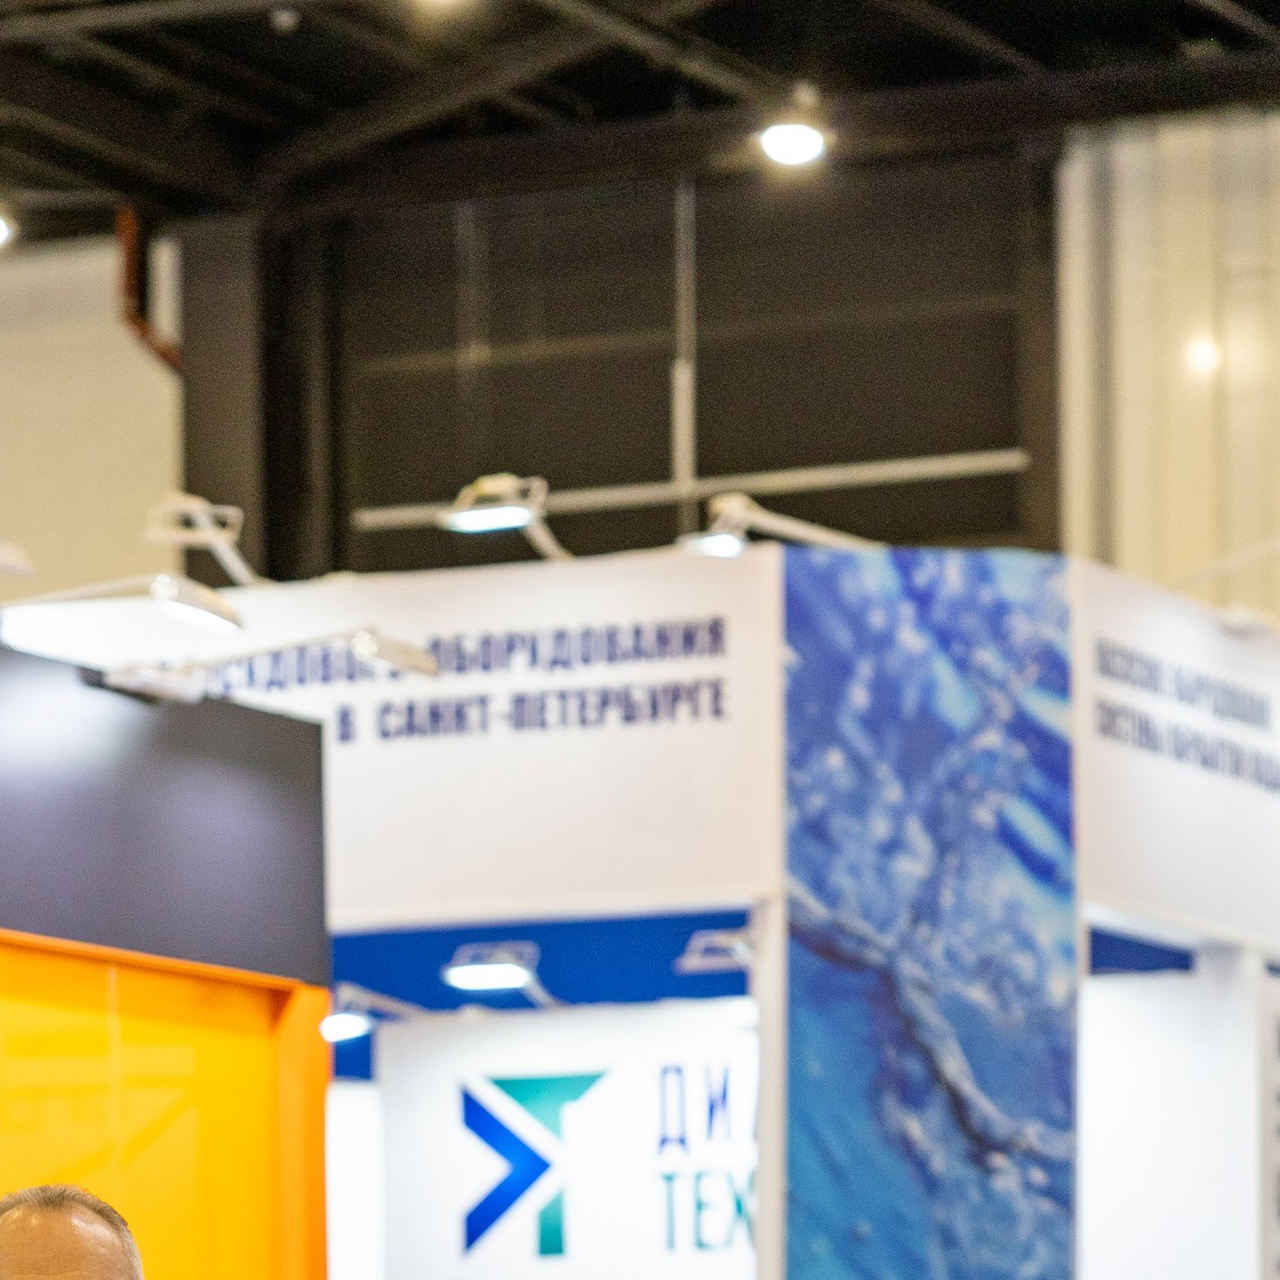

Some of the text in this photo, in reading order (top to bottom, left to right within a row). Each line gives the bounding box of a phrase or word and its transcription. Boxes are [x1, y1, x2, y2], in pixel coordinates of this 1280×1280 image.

[427, 614, 728, 677] ОБОРУДОВАНИЯ
[376, 676, 729, 741] САНКТ-ПЕТЕРБУРГЕ
[656, 1065, 757, 1154] ДИ
